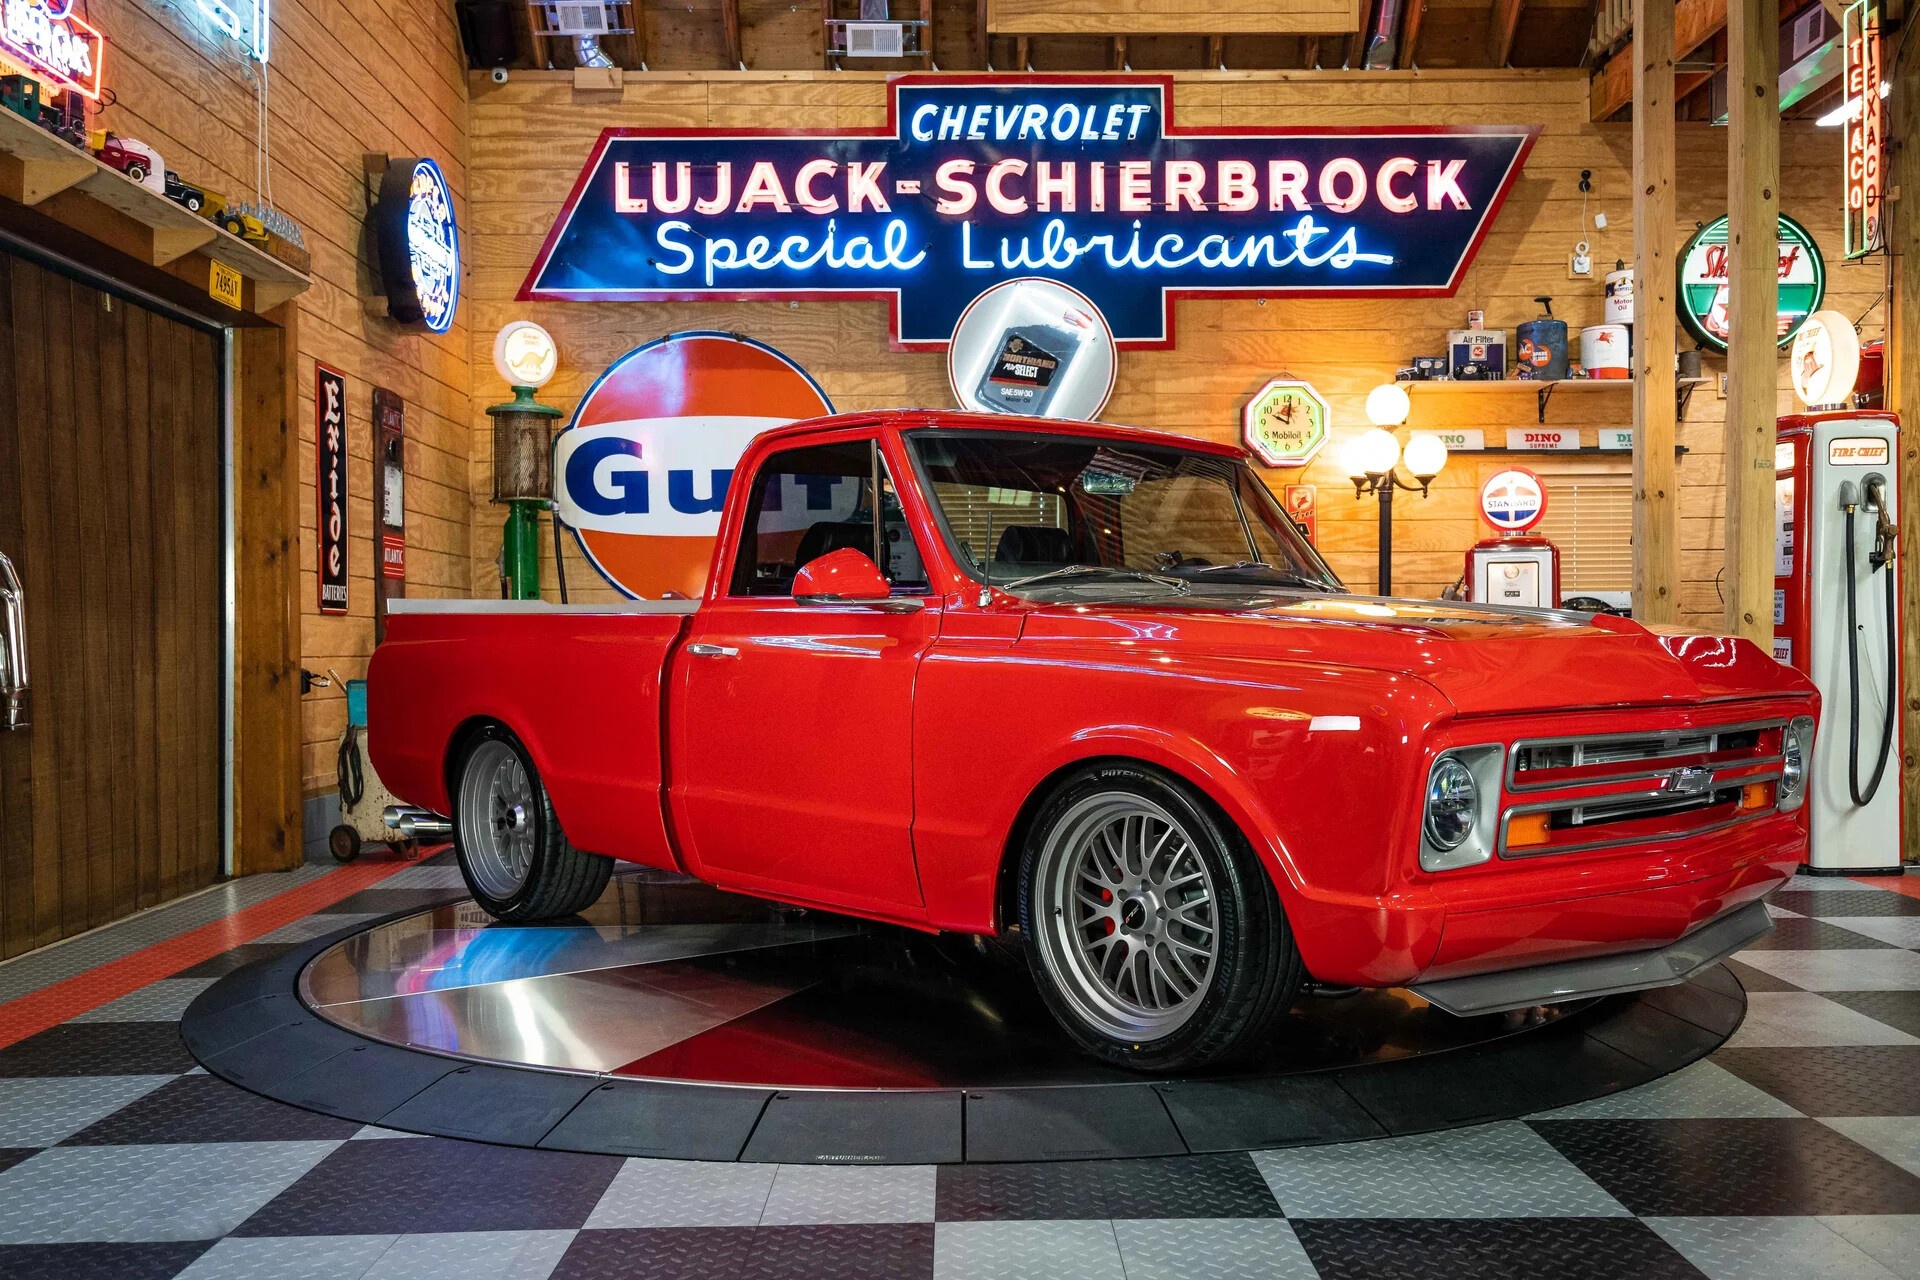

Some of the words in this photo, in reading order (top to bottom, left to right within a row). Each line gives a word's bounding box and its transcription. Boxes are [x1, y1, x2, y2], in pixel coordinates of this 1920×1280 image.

[911, 103, 1151, 142] CHEVROLET
[1849, 38, 1864, 210] TEACO
[1867, 35, 1877, 207] TEXACO
[650, 218, 928, 287] Special
[962, 214, 1395, 270] Lubricants
[1463, 335, 1474, 344] Air
[1475, 335, 1495, 344] Filter
[1473, 348, 1483, 356] AC
[1520, 342, 1532, 355] AC
[1001, 387, 1014, 397] SAE
[1283, 394, 1292, 403] 12
[1263, 406, 1273, 414] 10
[1306, 406, 1311, 414] 2
[1260, 419, 1266, 427] 9
[1309, 419, 1314, 427] 3
[1264, 431, 1270, 439] 8
[1271, 431, 1302, 439] Mobiloil
[1524, 433, 1562, 442] DINO
[1284, 443, 1291, 451] 6
[324, 379, 342, 578] Exide
[384, 547, 404, 564] ATLANTIC
[322, 583, 347, 602] BATTERIES
[1019, 847, 1034, 941] BRIDGESTONE
[1216, 887, 1234, 998] BRIDGESTONE
